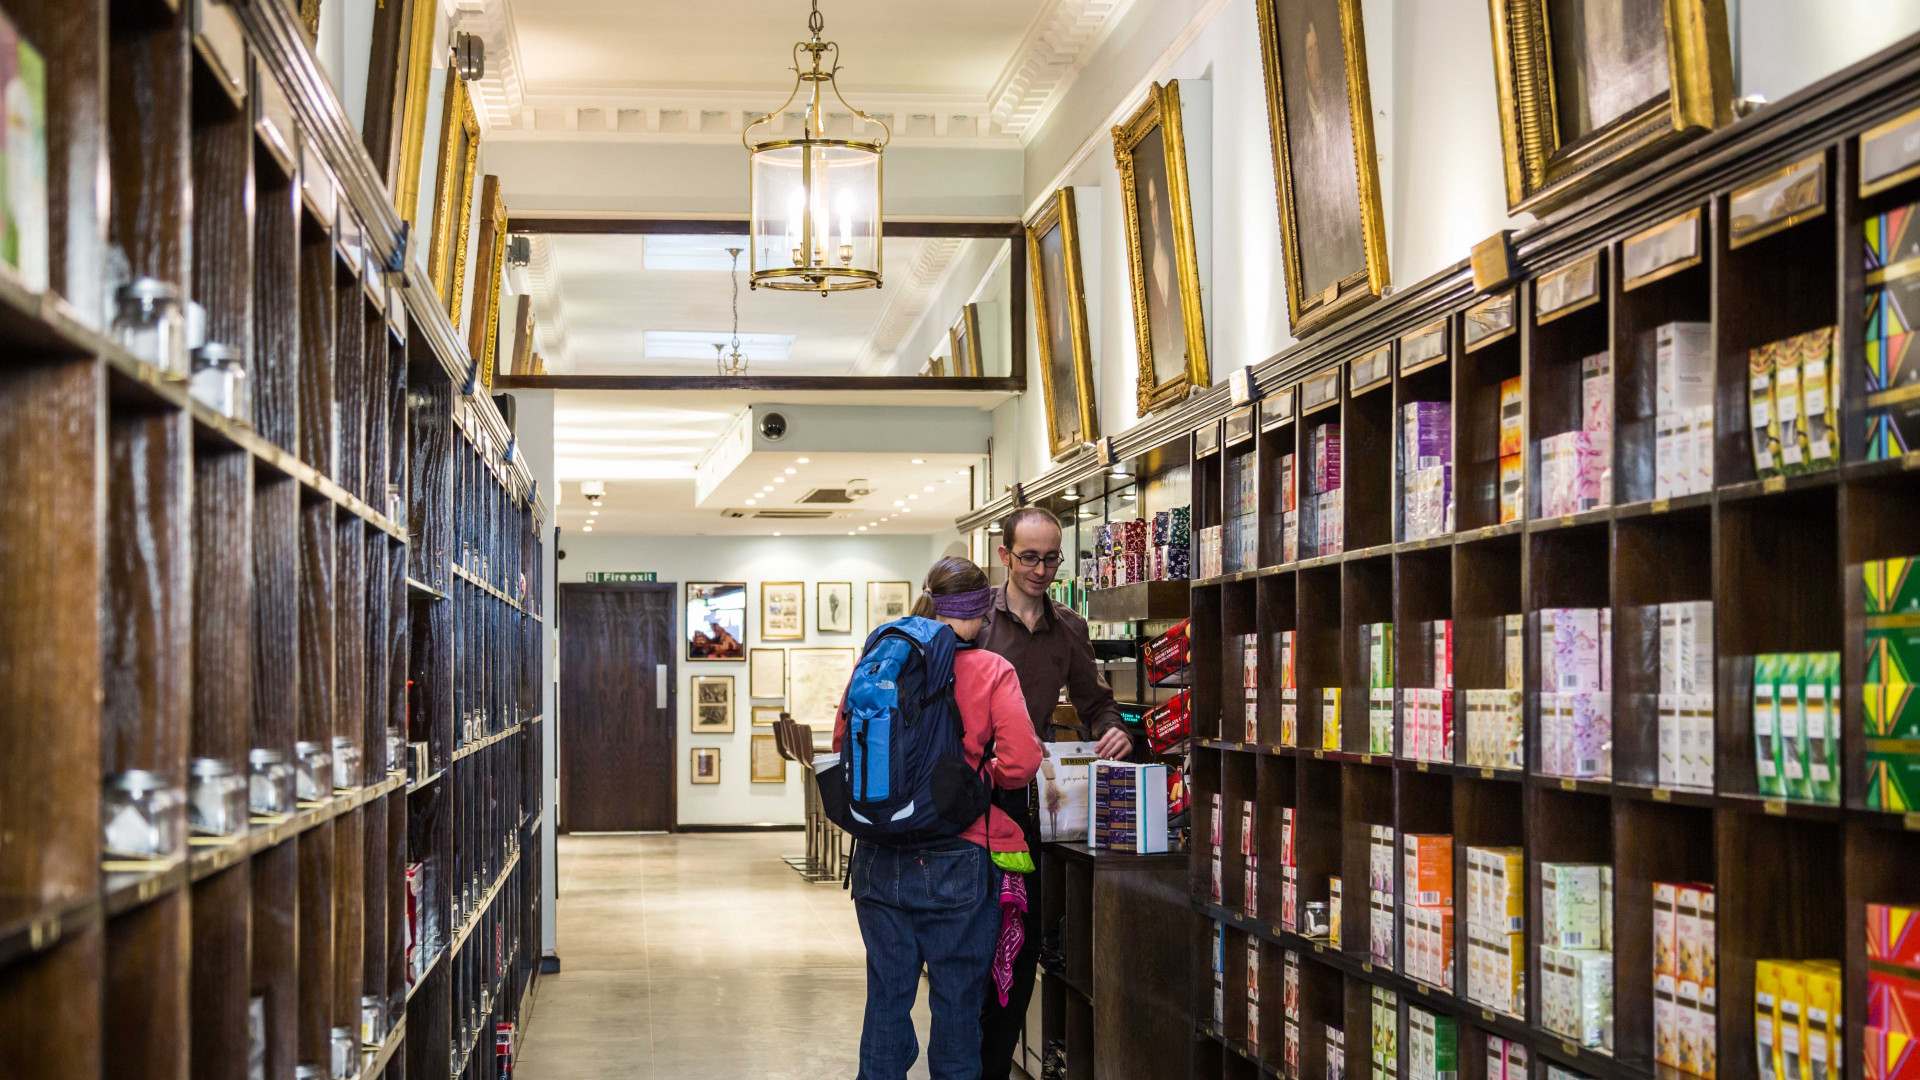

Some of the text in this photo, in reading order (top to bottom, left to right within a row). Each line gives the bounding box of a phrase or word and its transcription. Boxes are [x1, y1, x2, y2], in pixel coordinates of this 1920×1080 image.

[603, 573, 653, 581] Fire exit
[1151, 637, 1168, 649] Walkers
